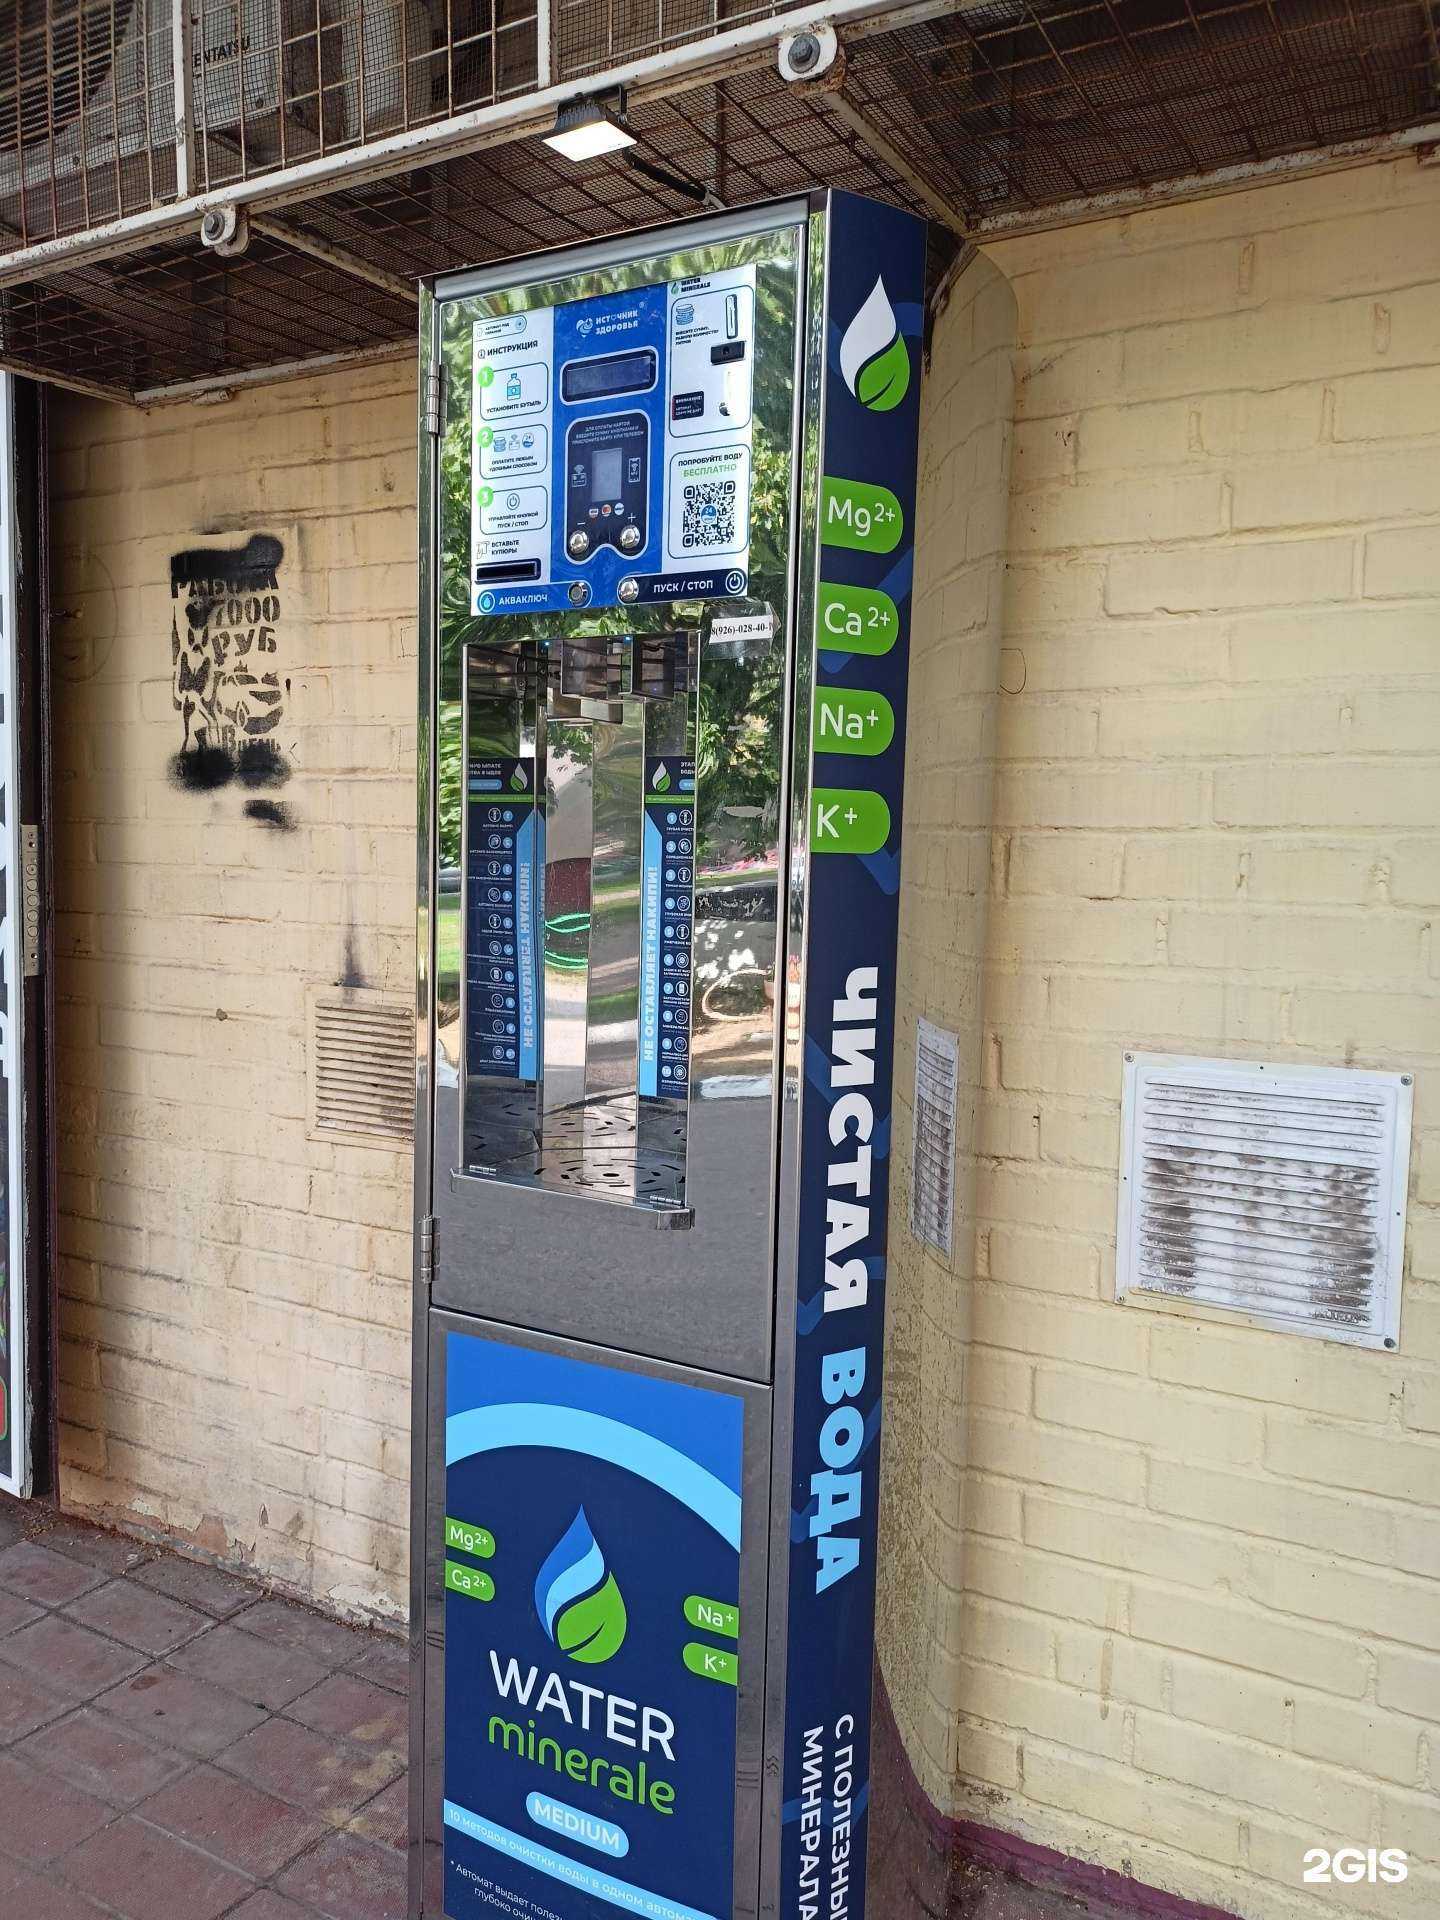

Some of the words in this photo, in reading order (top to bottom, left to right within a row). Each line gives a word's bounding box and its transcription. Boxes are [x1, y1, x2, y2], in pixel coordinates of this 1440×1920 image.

[194, 35, 250, 67] ENTATSU
[595, 310, 638, 325] ИСТОЧНИК
[595, 320, 638, 336] ЗДОРОВЬЯ
[487, 340, 538, 356] ИНСТРУКЦИЯ
[487, 404, 519, 414] УСТАНОВИТЕ
[678, 454, 723, 467] ПОПРОБУЙТЕ
[724, 452, 743, 461] ВОДУ
[683, 463, 737, 478] БЕСПЛАТНО
[492, 548, 517, 556] КУПЮРЫ
[499, 594, 548, 605] АКВАКЛЮЧ
[653, 583, 679, 593] ПУСК
[687, 579, 713, 591] СТОП
[212, 626, 277, 666] РУБ
[819, 703, 879, 739] Na+
[816, 803, 858, 839] K+
[646, 866, 657, 940] НАКИПИ!
[644, 944, 656, 1036] ОСТАВЛЯЕТ
[643, 1041, 654, 1062] НЕ
[823, 966, 878, 1315] ЧИСТАЯ
[809, 1346, 867, 1595] ВОДА
[696, 1603, 734, 1628] Na+
[703, 1652, 728, 1673] K+
[488, 1649, 677, 1762] WATER
[834, 1713, 854, 1740] С
[487, 1715, 677, 1815] minerale
[534, 1799, 621, 1851] MEDIUM
[830, 1744, 853, 1920] ПОЛЕЗНЫ
[449, 1808, 460, 1820] 10
[463, 1817, 507, 1846] методов
[509, 1841, 555, 1869] очистки
[558, 1864, 589, 1885] воды
[592, 1878, 600, 1889] в
[602, 1883, 643, 1907] одном
[456, 1863, 494, 1889] Автомат
[495, 1885, 528, 1908] выдает
[474, 1887, 511, 1912] глубоко
